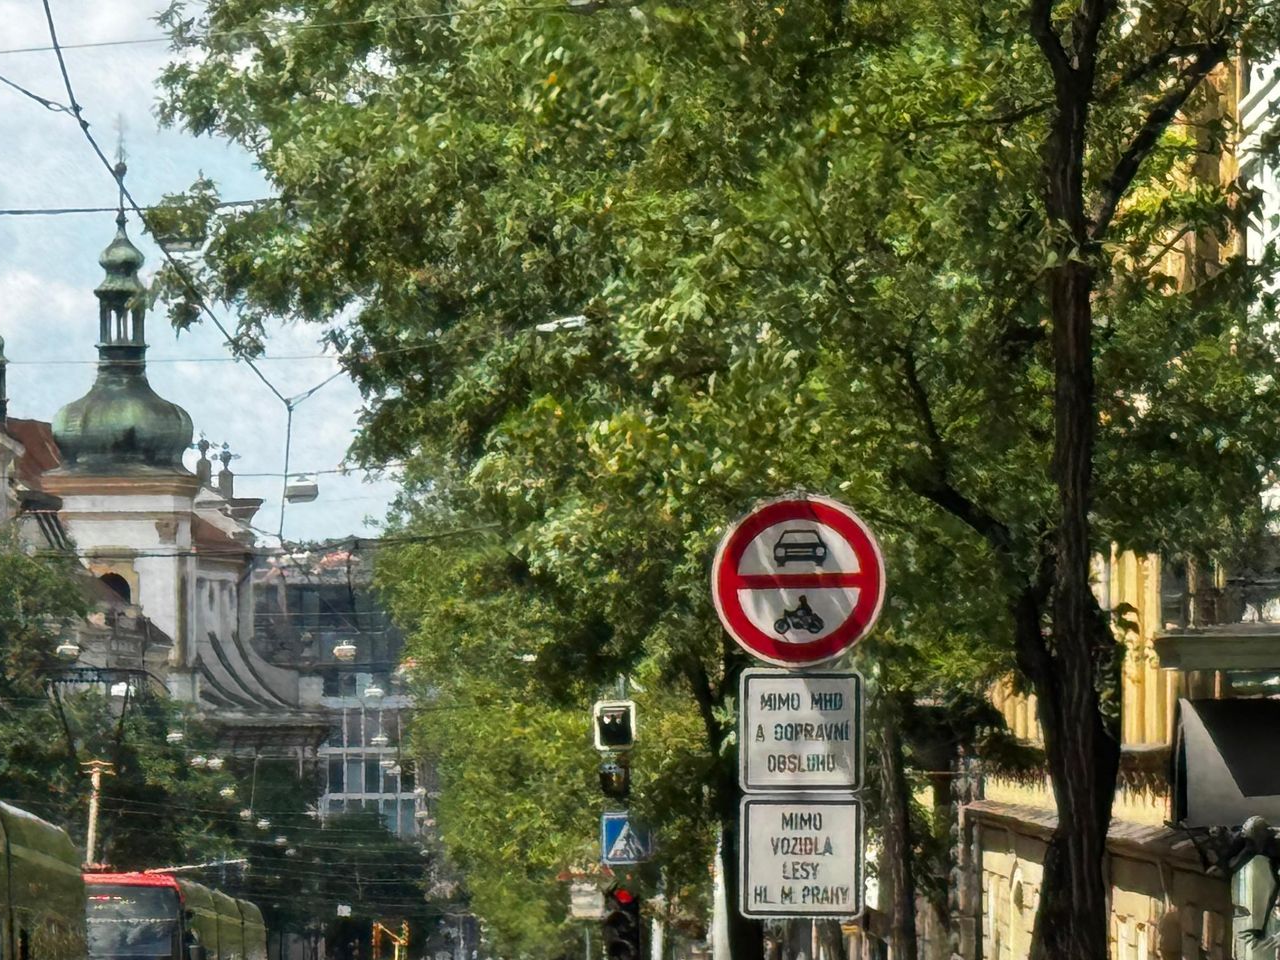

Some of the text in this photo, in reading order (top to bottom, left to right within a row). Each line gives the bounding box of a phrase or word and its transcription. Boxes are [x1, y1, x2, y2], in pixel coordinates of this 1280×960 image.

[760, 692, 844, 711] MIMO MHD
[755, 719, 850, 742] A DOPRAVNÍ
[767, 753, 836, 773] OBSLUHU
[781, 811, 823, 831] MIMO
[770, 836, 833, 856] VOZIDLA
[782, 861, 819, 880] LESY
[802, 885, 849, 905] PRAHY
